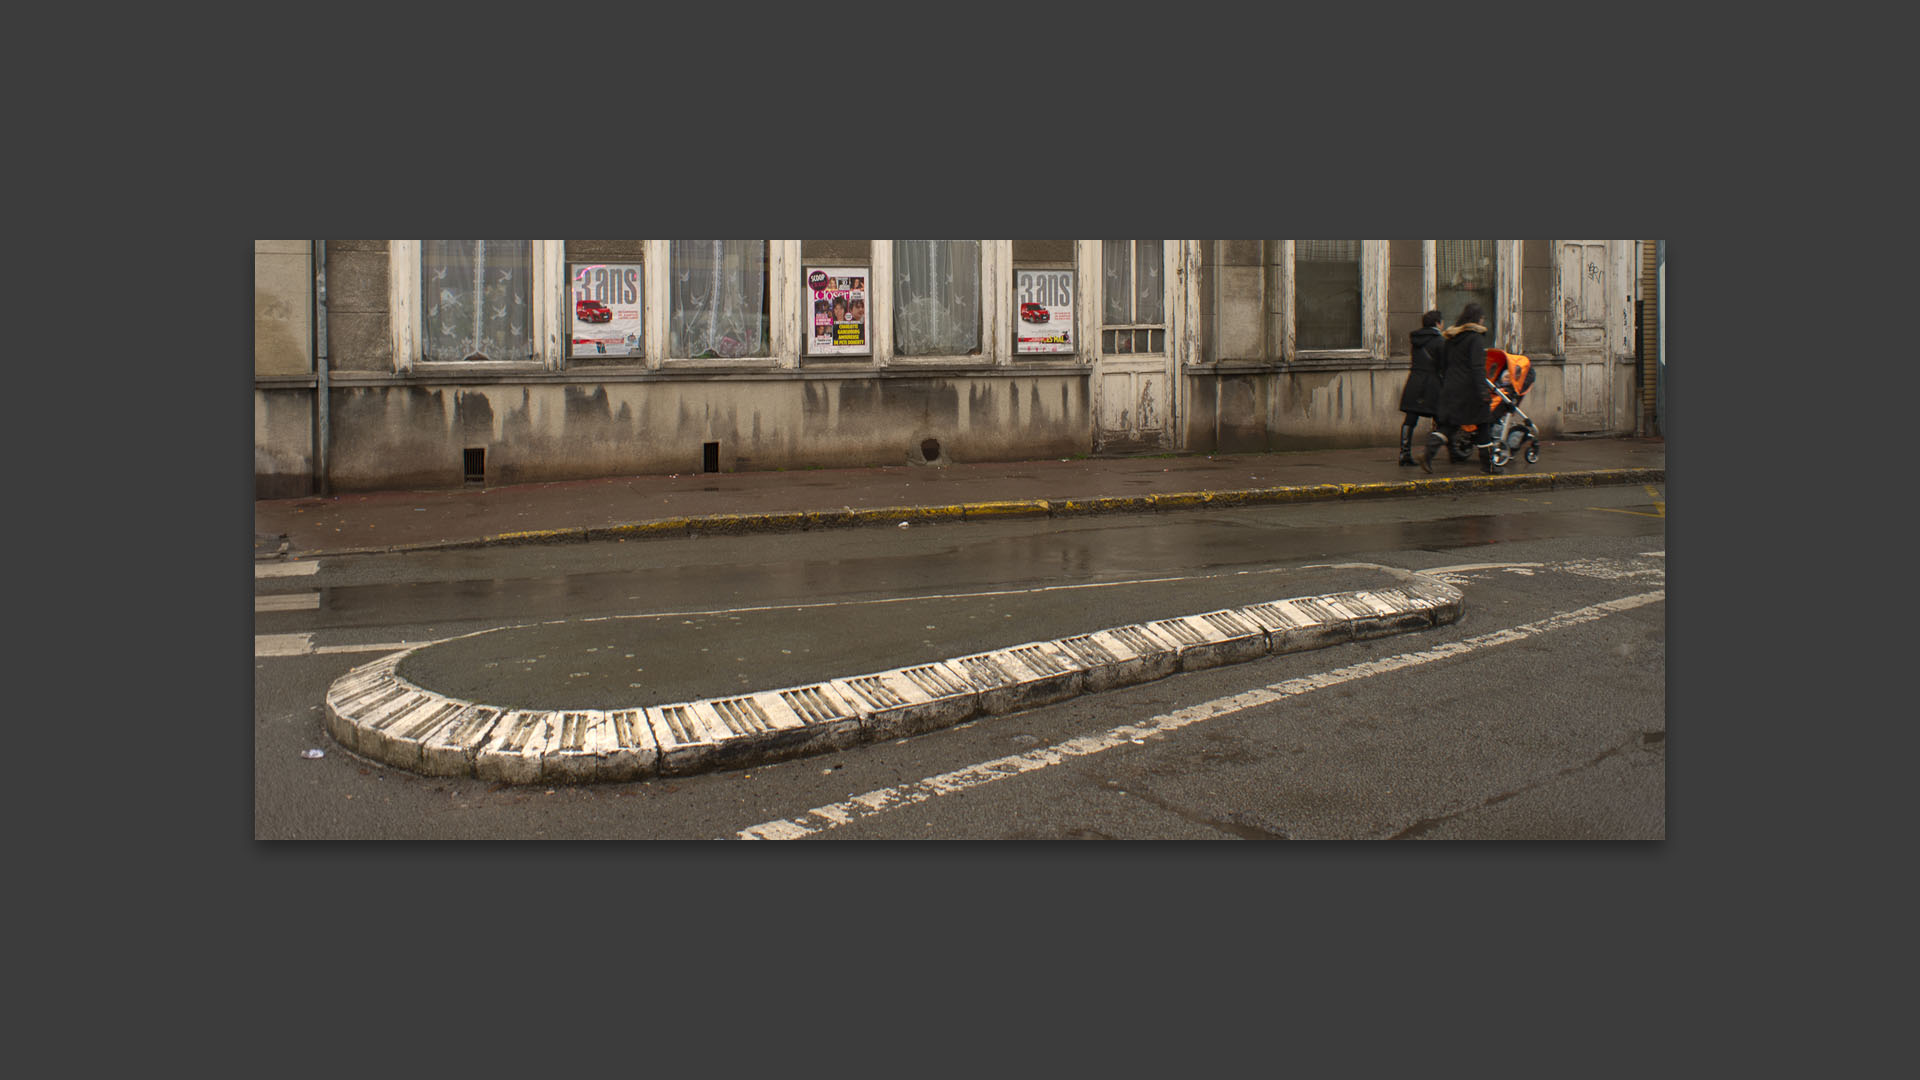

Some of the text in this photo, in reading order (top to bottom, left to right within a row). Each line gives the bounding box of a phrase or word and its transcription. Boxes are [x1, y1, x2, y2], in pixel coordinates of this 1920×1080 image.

[576, 268, 637, 304] 3 ans
[1021, 274, 1070, 306] 3 ans
